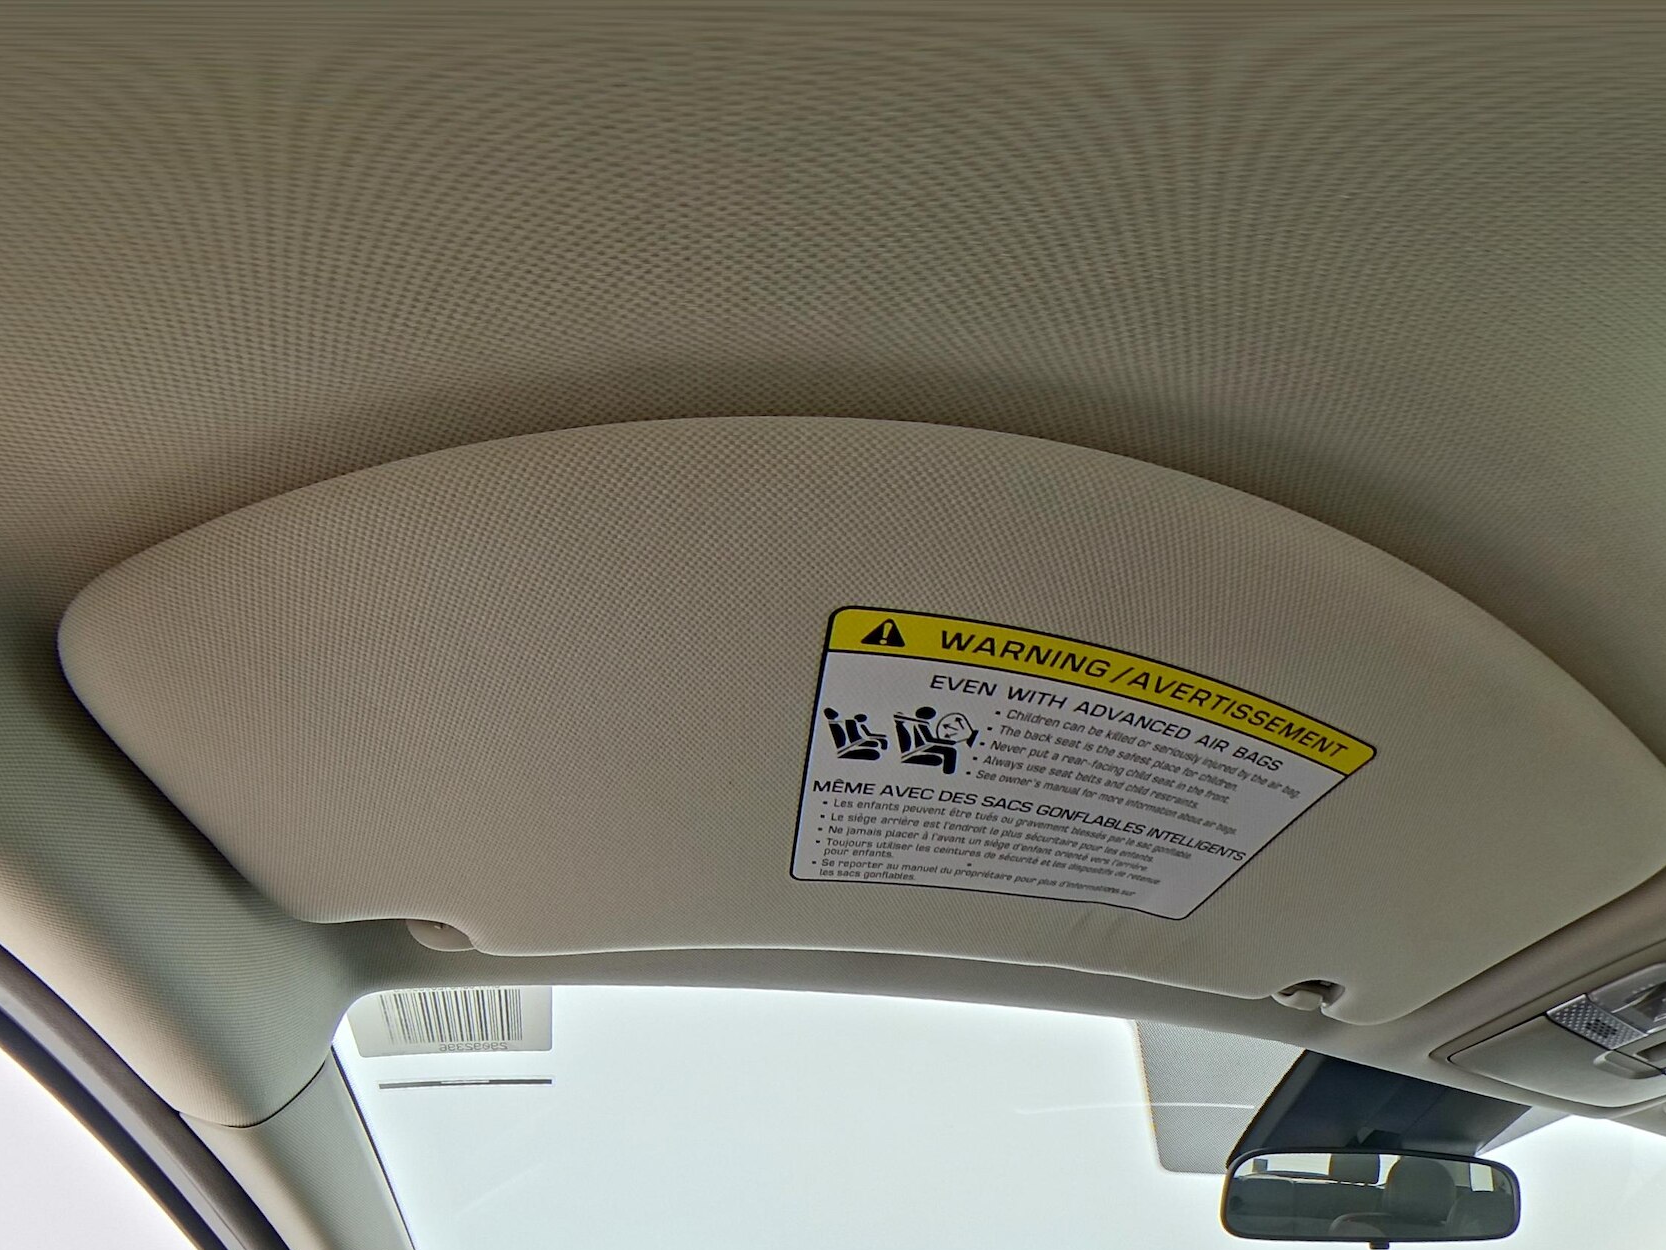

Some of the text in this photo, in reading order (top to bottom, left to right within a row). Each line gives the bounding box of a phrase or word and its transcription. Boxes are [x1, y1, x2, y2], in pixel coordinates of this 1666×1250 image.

[930, 675, 1284, 772] EVEN WITH ADVANCED AIR BAGS
[1000, 724, 1021, 738] The
[1024, 729, 1053, 743] back
[1054, 736, 1082, 749] seat
[1083, 742, 1095, 752] is
[1096, 744, 1116, 757] the
[1006, 708, 1061, 728] Children
[1063, 721, 1086, 733] can
[1088, 725, 1104, 737] be
[1105, 729, 1138, 745] killed
[983, 754, 1024, 771] Always
[1026, 763, 1047, 774] use
[1049, 767, 1074, 779] seat
[1075, 771, 1103, 785] belts
[1104, 778, 1125, 790] and
[990, 740, 1027, 754] Never
[1027, 748, 1050, 759] put
[1051, 752, 1060, 761] a
[1061, 754, 1125, 777] rear-facing
[976, 769, 997, 781] See
[999, 774, 1042, 788] owner's
[1043, 782, 1082, 796] manual
[1081, 787, 1098, 798] for
[1098, 793, 1124, 805] more
[813, 778, 1247, 861] MÊME AVEC DES SACS GONFLABLES INTELLIGENTS
[831, 812, 844, 822] Le
[923, 820, 941, 829] est
[943, 820, 987, 834] l'endroit
[990, 826, 1000, 836] le
[1000, 829, 1023, 839] plus
[1078, 842, 1103, 852] pour
[1104, 845, 1119, 855] les
[834, 798, 854, 808] Les
[857, 800, 900, 811] enfants
[902, 804, 946, 816] peuvent
[1001, 815, 1014, 824] ou
[1015, 818, 1070, 833] gravement
[1106, 834, 1126, 844] par
[824, 847, 849, 857] pour
[827, 837, 873, 848] Toujours
[876, 841, 913, 851] utiliser
[916, 843, 931, 853] les
[934, 846, 981, 858] ceintures
[984, 850, 997, 859] de
[1040, 859, 1051, 867] et
[1052, 859, 1067, 869] les
[828, 825, 843, 834] Ne
[846, 826, 882, 836] jamais
[885, 829, 920, 839] placer
[931, 832, 966, 844] l'avant
[969, 837, 982, 845] un
[1012, 842, 1053, 855] d'enfant
[1090, 856, 1111, 865] vers
[820, 868, 835, 877] les
[837, 869, 861, 878] sacs
[822, 857, 835, 867] Se
[838, 860, 884, 870] reporter
[901, 864, 938, 874] manuel
[940, 866, 953, 875] du
[1013, 875, 1037, 884] pour
[1037, 878, 1058, 887] plus
[1058, 880, 1120, 894] d'informations
